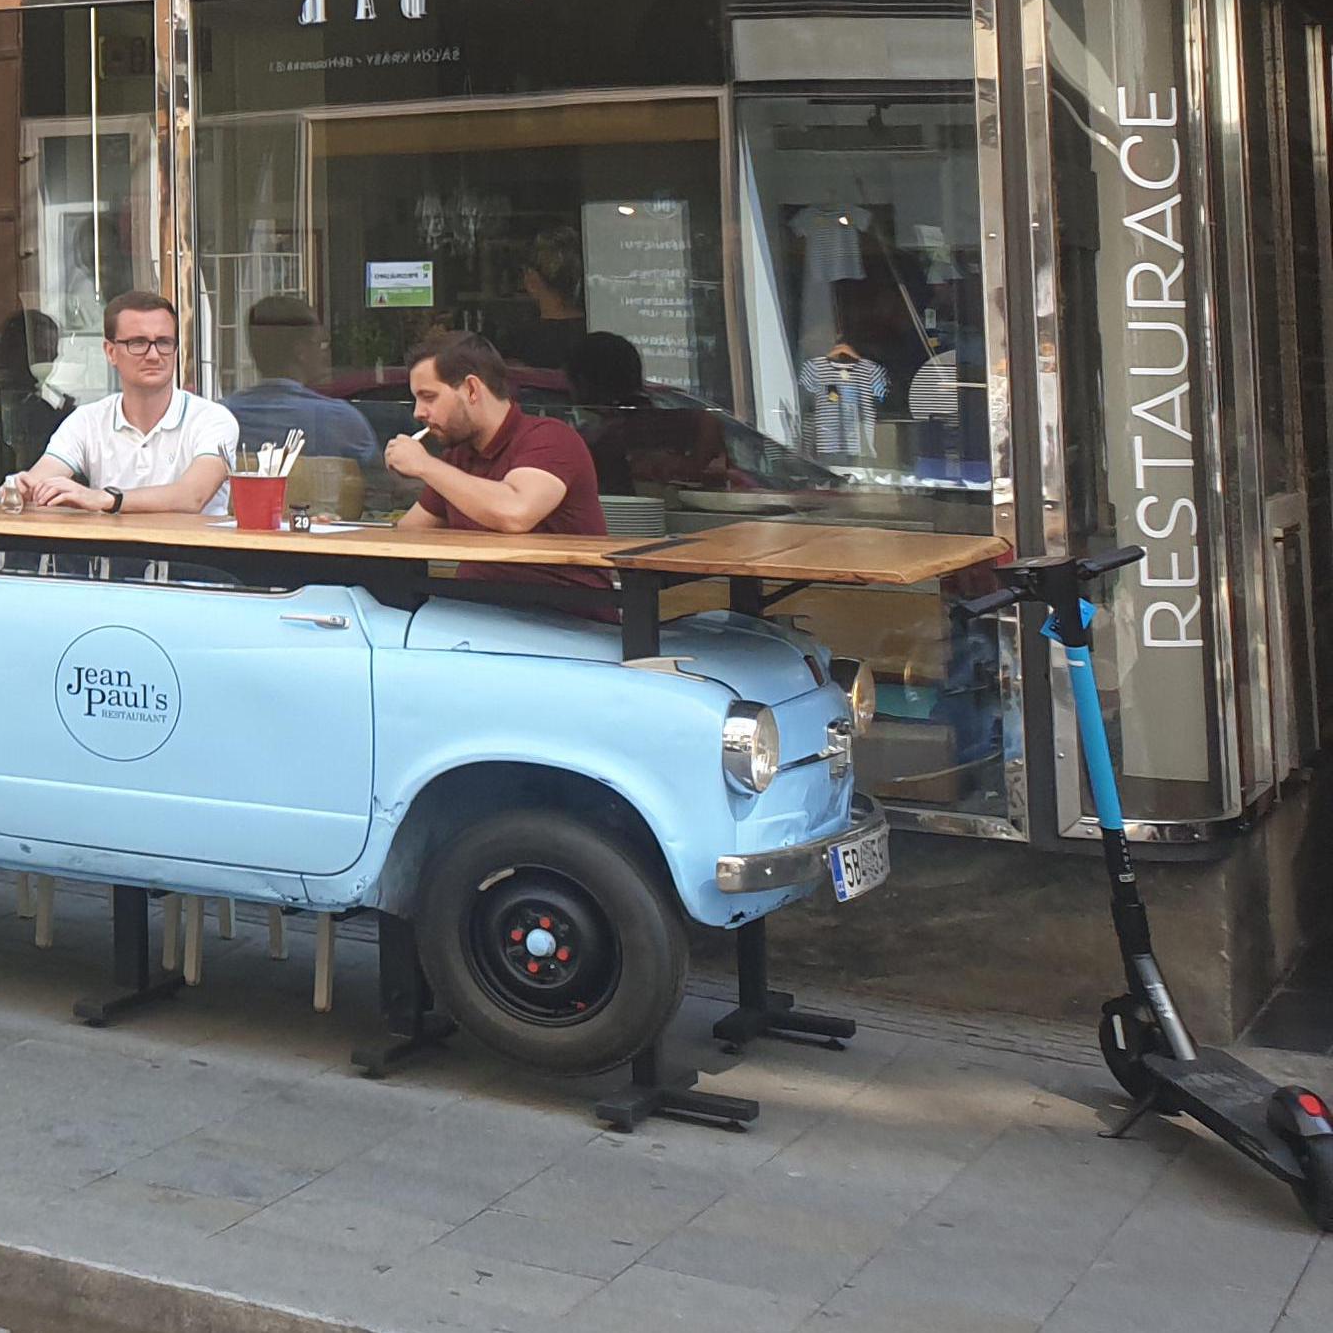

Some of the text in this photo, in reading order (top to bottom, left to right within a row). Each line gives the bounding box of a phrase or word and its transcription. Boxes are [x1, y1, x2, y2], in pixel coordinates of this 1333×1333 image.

[1117, 86, 1204, 648] RESTAURACE
[294, 516, 310, 529] 29
[66, 666, 133, 696] Jean
[83, 683, 169, 717] Paul's
[101, 709, 168, 724] RESTAURANT
